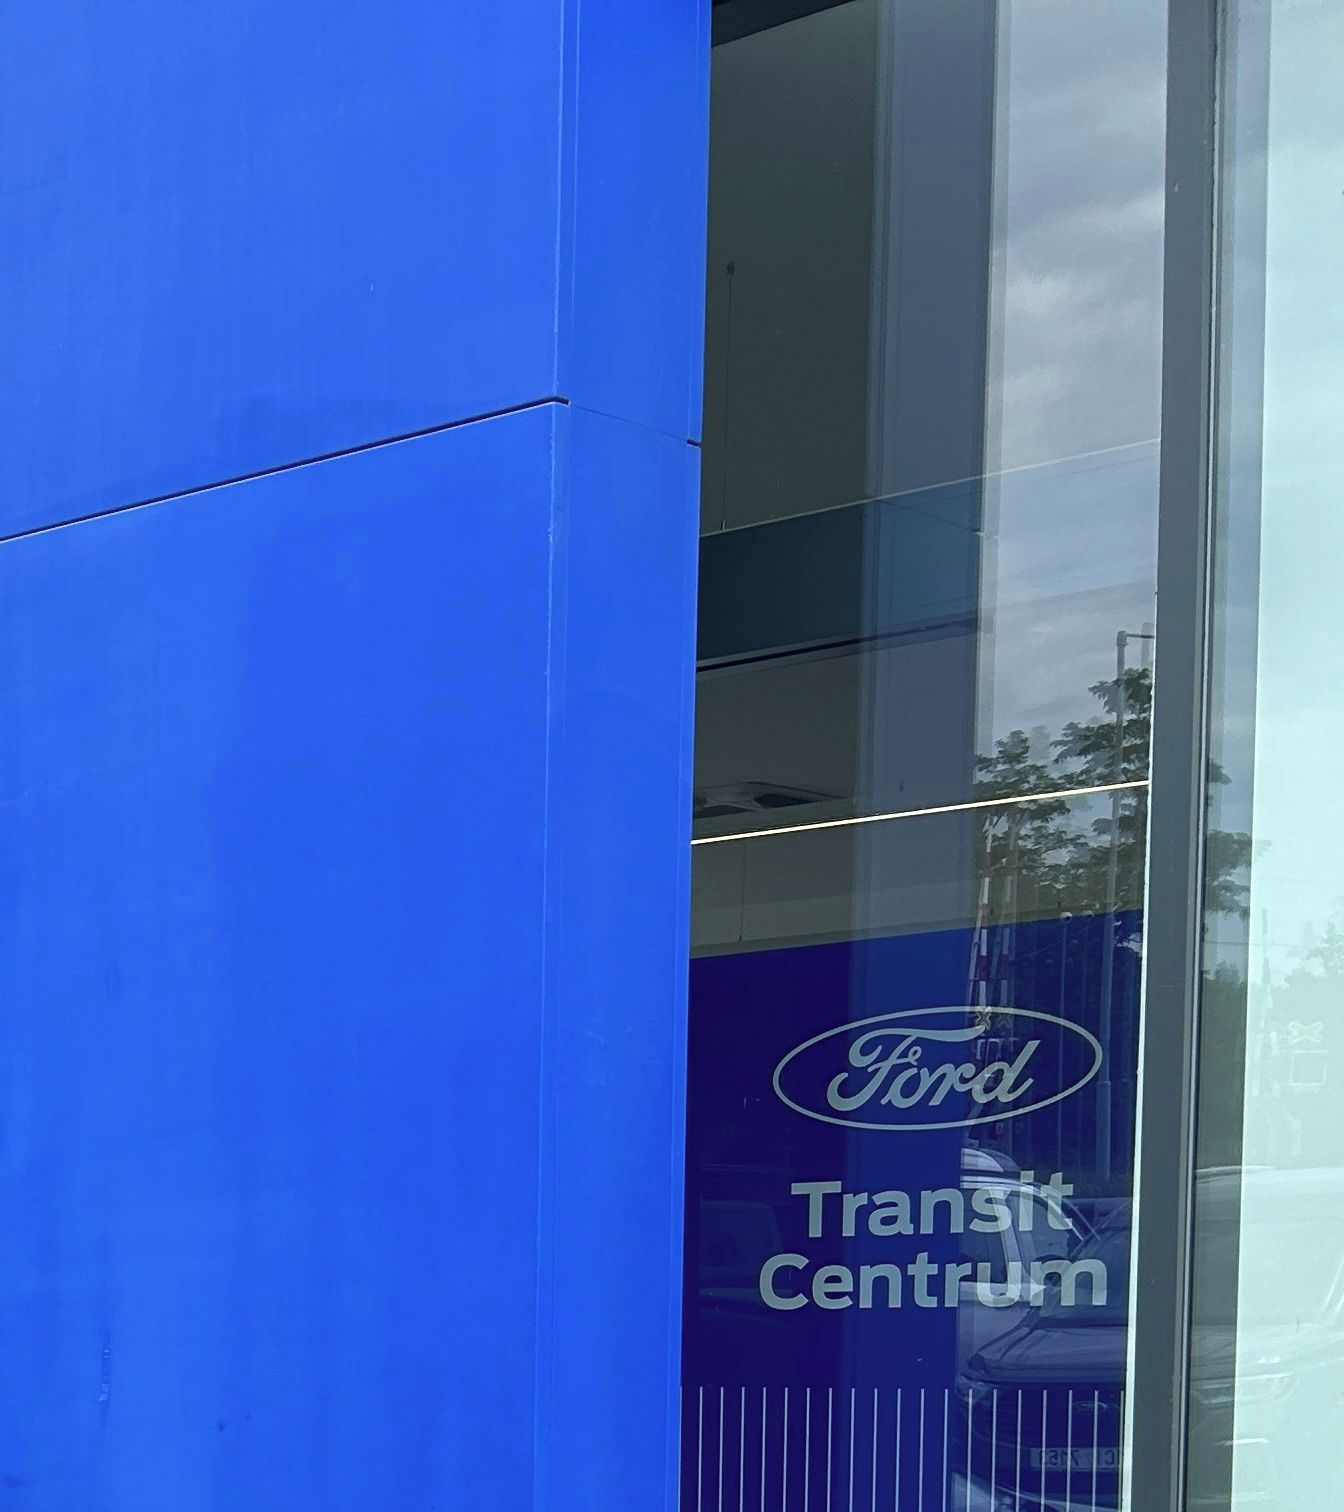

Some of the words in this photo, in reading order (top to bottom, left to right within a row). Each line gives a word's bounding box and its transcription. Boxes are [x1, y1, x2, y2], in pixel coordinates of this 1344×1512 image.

[825, 1026, 1042, 1111] Ford
[791, 1170, 1074, 1239] Transit
[758, 1253, 1109, 1311] Centrum
